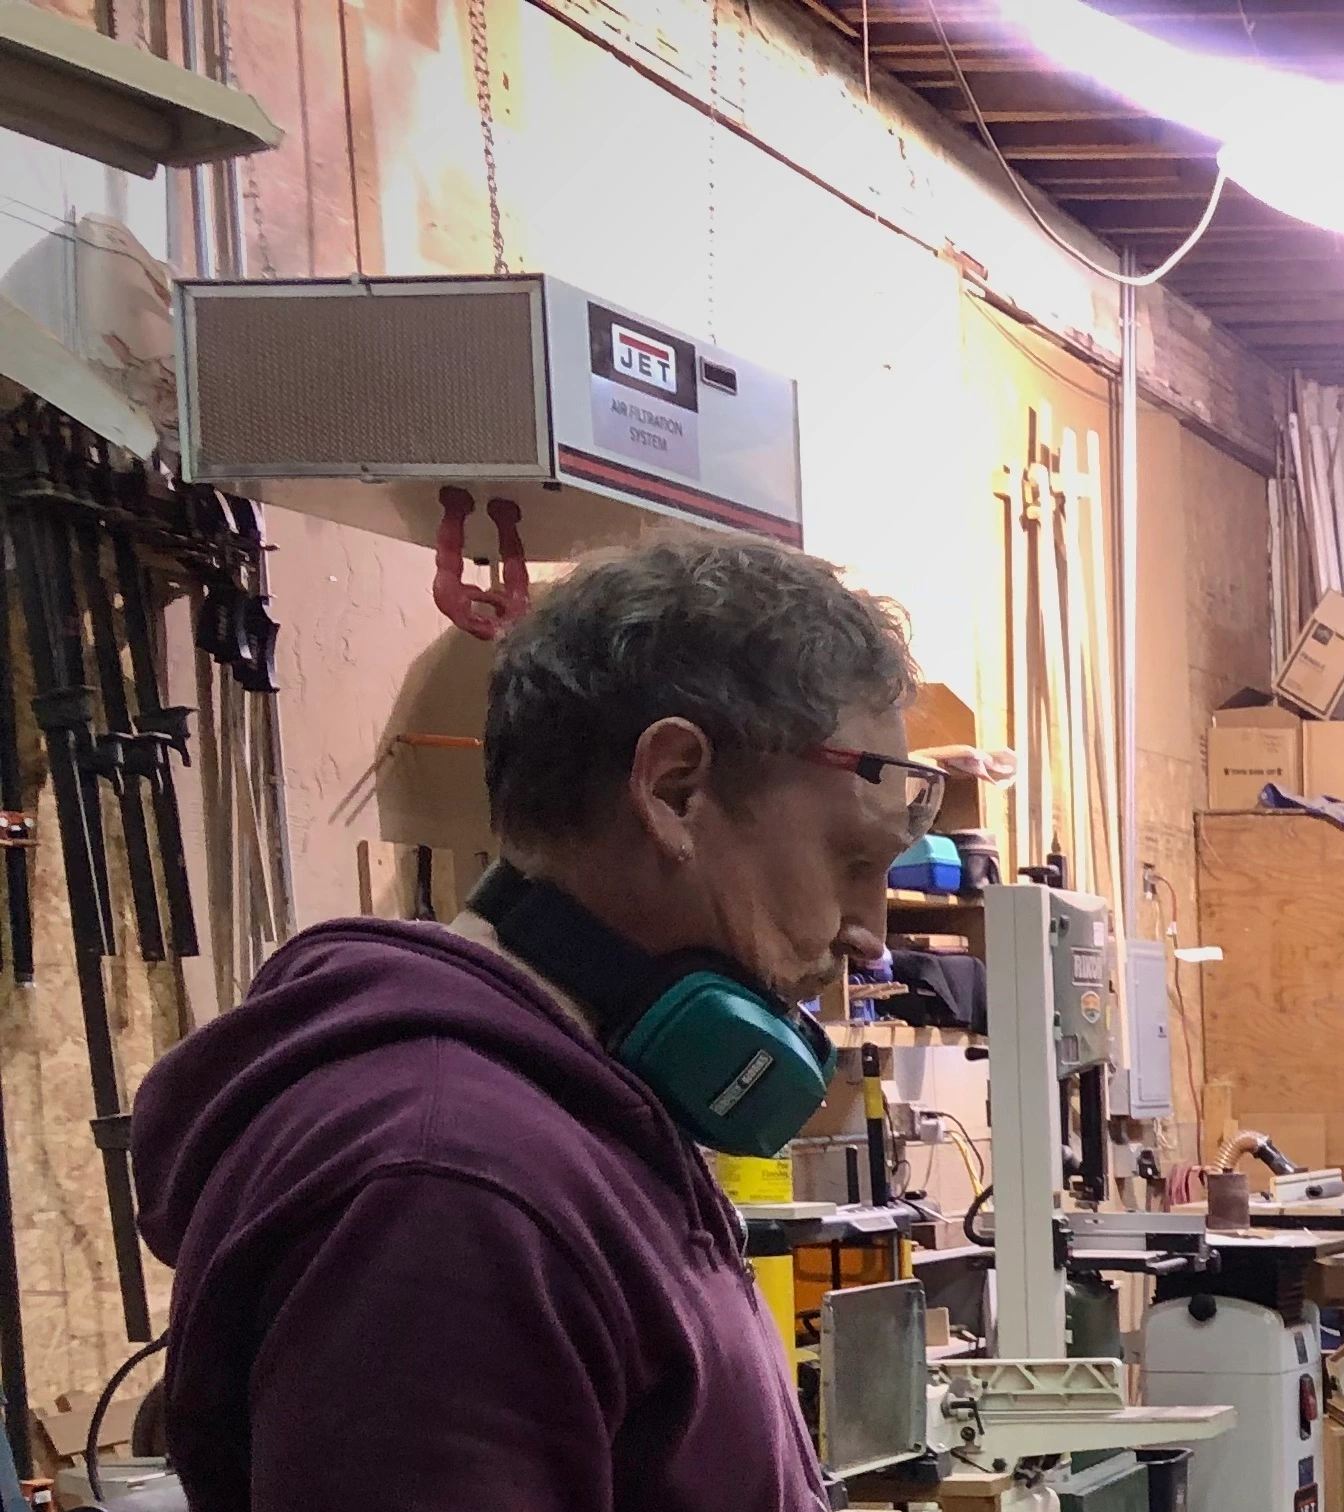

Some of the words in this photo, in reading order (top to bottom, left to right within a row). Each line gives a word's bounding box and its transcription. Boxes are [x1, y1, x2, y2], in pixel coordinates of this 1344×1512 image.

[620, 347, 670, 383] JET
[610, 398, 628, 418] AIR
[626, 406, 684, 437] FILTRATION
[629, 427, 668, 451] SYSTEM
